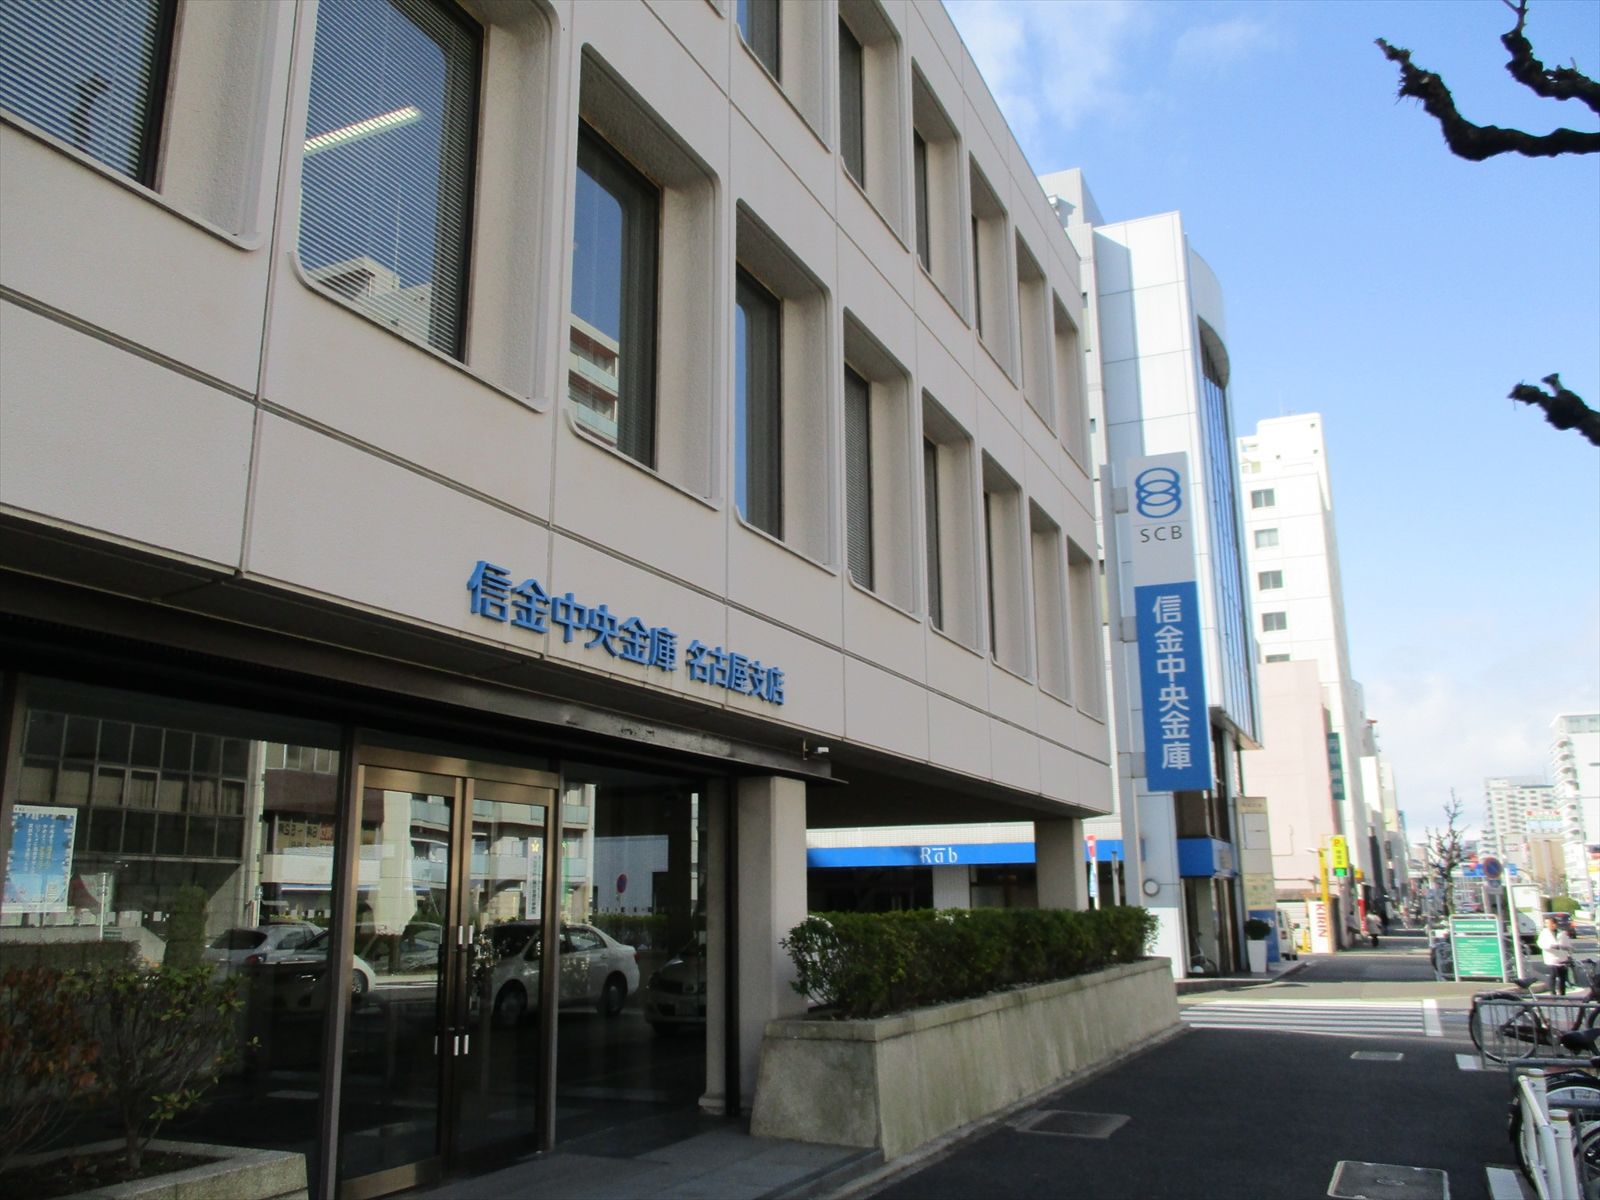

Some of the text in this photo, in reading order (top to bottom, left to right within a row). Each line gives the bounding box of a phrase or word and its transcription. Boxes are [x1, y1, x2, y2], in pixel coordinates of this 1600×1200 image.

[1140, 524, 1183, 543] SCB
[467, 560, 785, 706] 信金中央金庫 名古屋支店
[1152, 595, 1192, 770] 信金中央金庫
[1316, 903, 1328, 938] KIRIN
